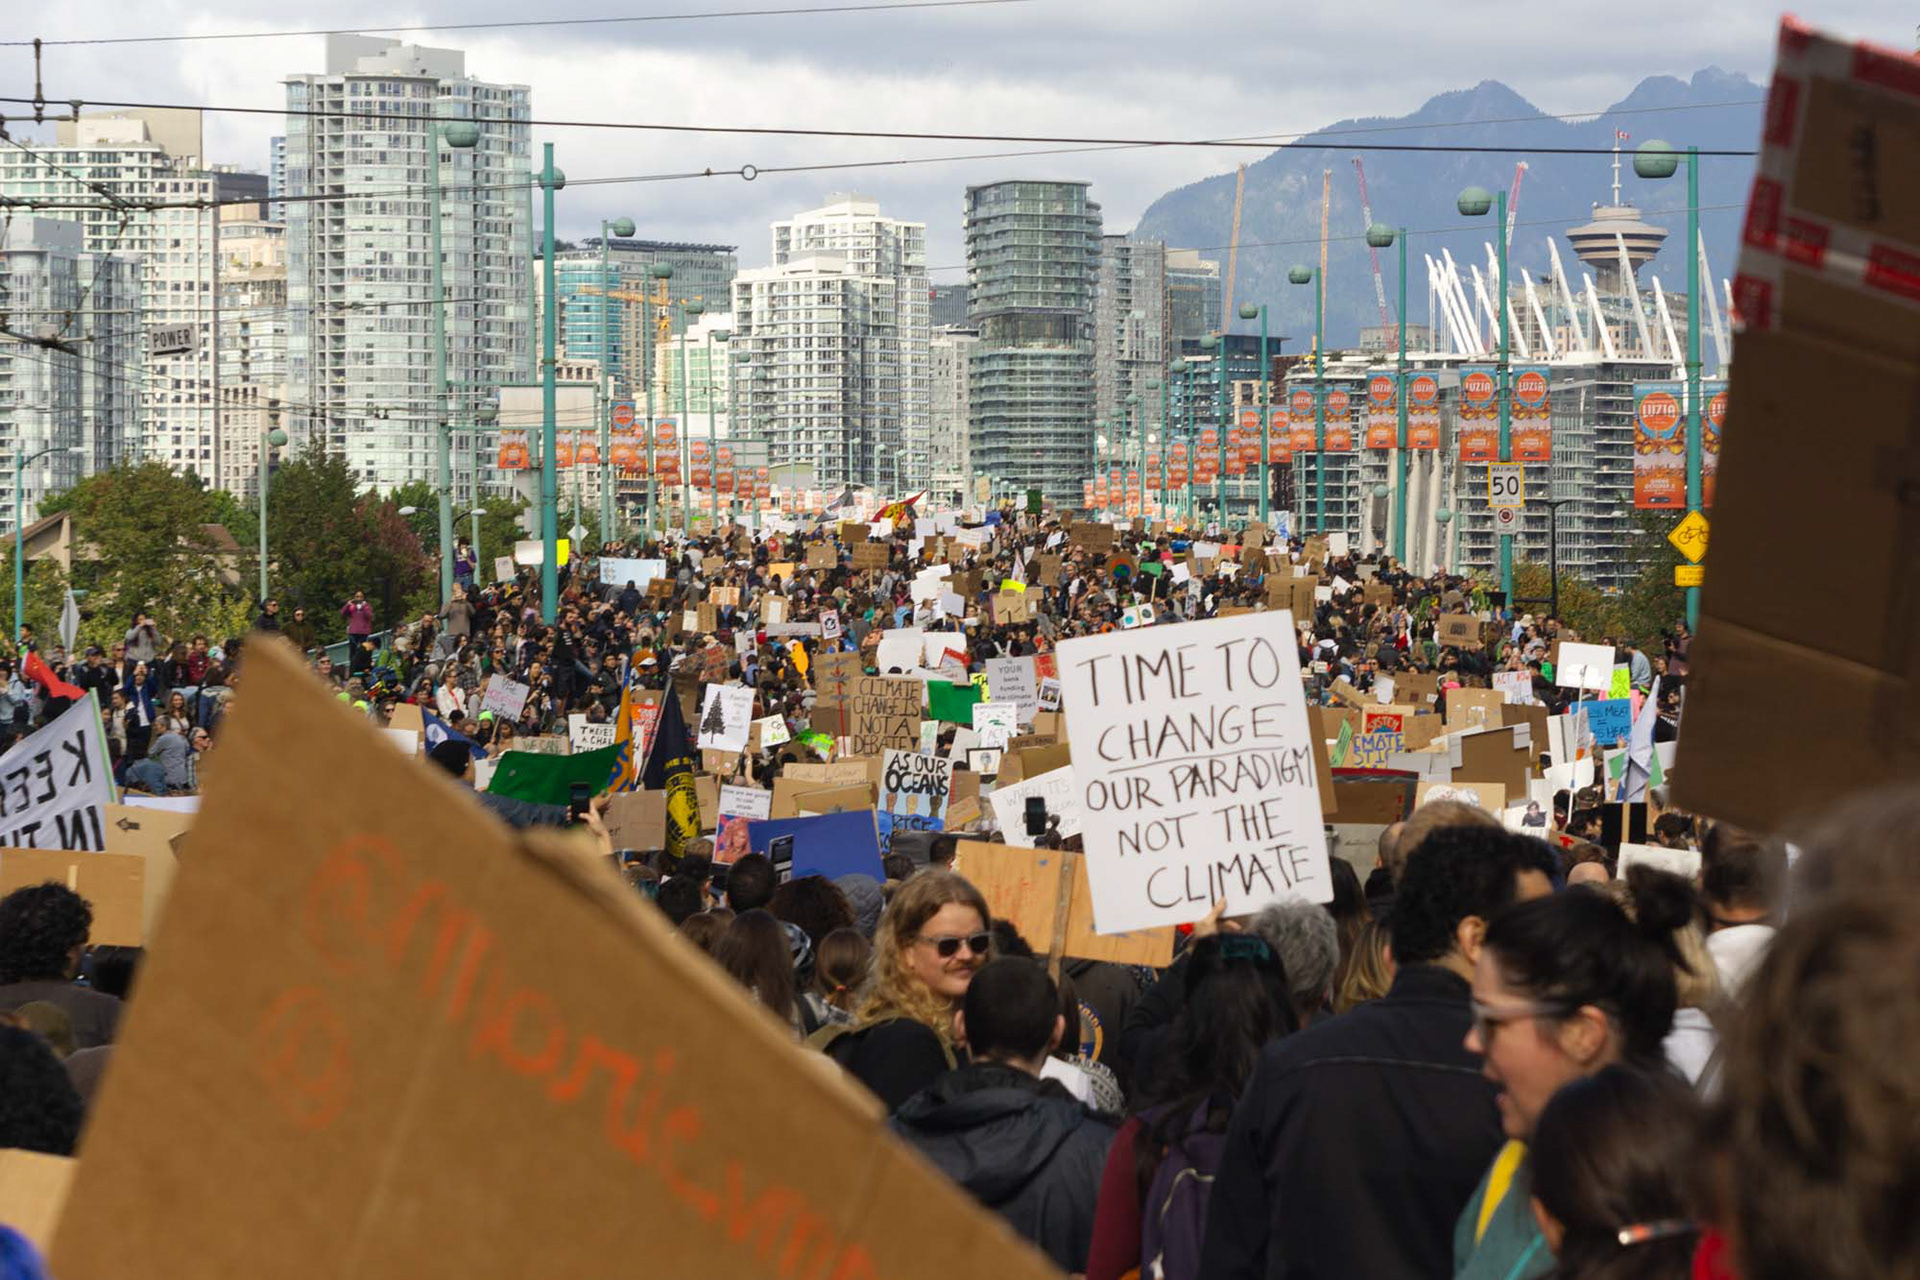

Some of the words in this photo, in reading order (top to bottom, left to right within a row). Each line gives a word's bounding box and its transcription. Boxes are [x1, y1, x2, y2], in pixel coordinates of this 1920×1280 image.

[153, 329, 191, 348] POWER
[1518, 382, 1544, 392] LUZIA
[1642, 404, 1675, 418] LUZIA
[1493, 476, 1519, 496] 50
[998, 665, 1022, 674] YOUR
[1076, 643, 1202, 706] TIME
[1215, 637, 1280, 691] TO
[860, 678, 919, 699] CLIMATE
[853, 696, 899, 716] CHANGE
[900, 698, 919, 717] IS
[1605, 706, 1629, 717] MEAT
[860, 715, 893, 735] NOT
[894, 717, 911, 736] A
[1098, 703, 1287, 762] CHANGE
[887, 752, 911, 770] AS
[915, 755, 947, 774] OUR
[885, 769, 949, 796] OCEANS
[1086, 776, 1164, 811] OUR
[1169, 745, 1313, 803] PARADIGM
[1119, 812, 1199, 857] NOT
[1212, 797, 1292, 843] THE
[1147, 844, 1314, 909] CLIMATE
